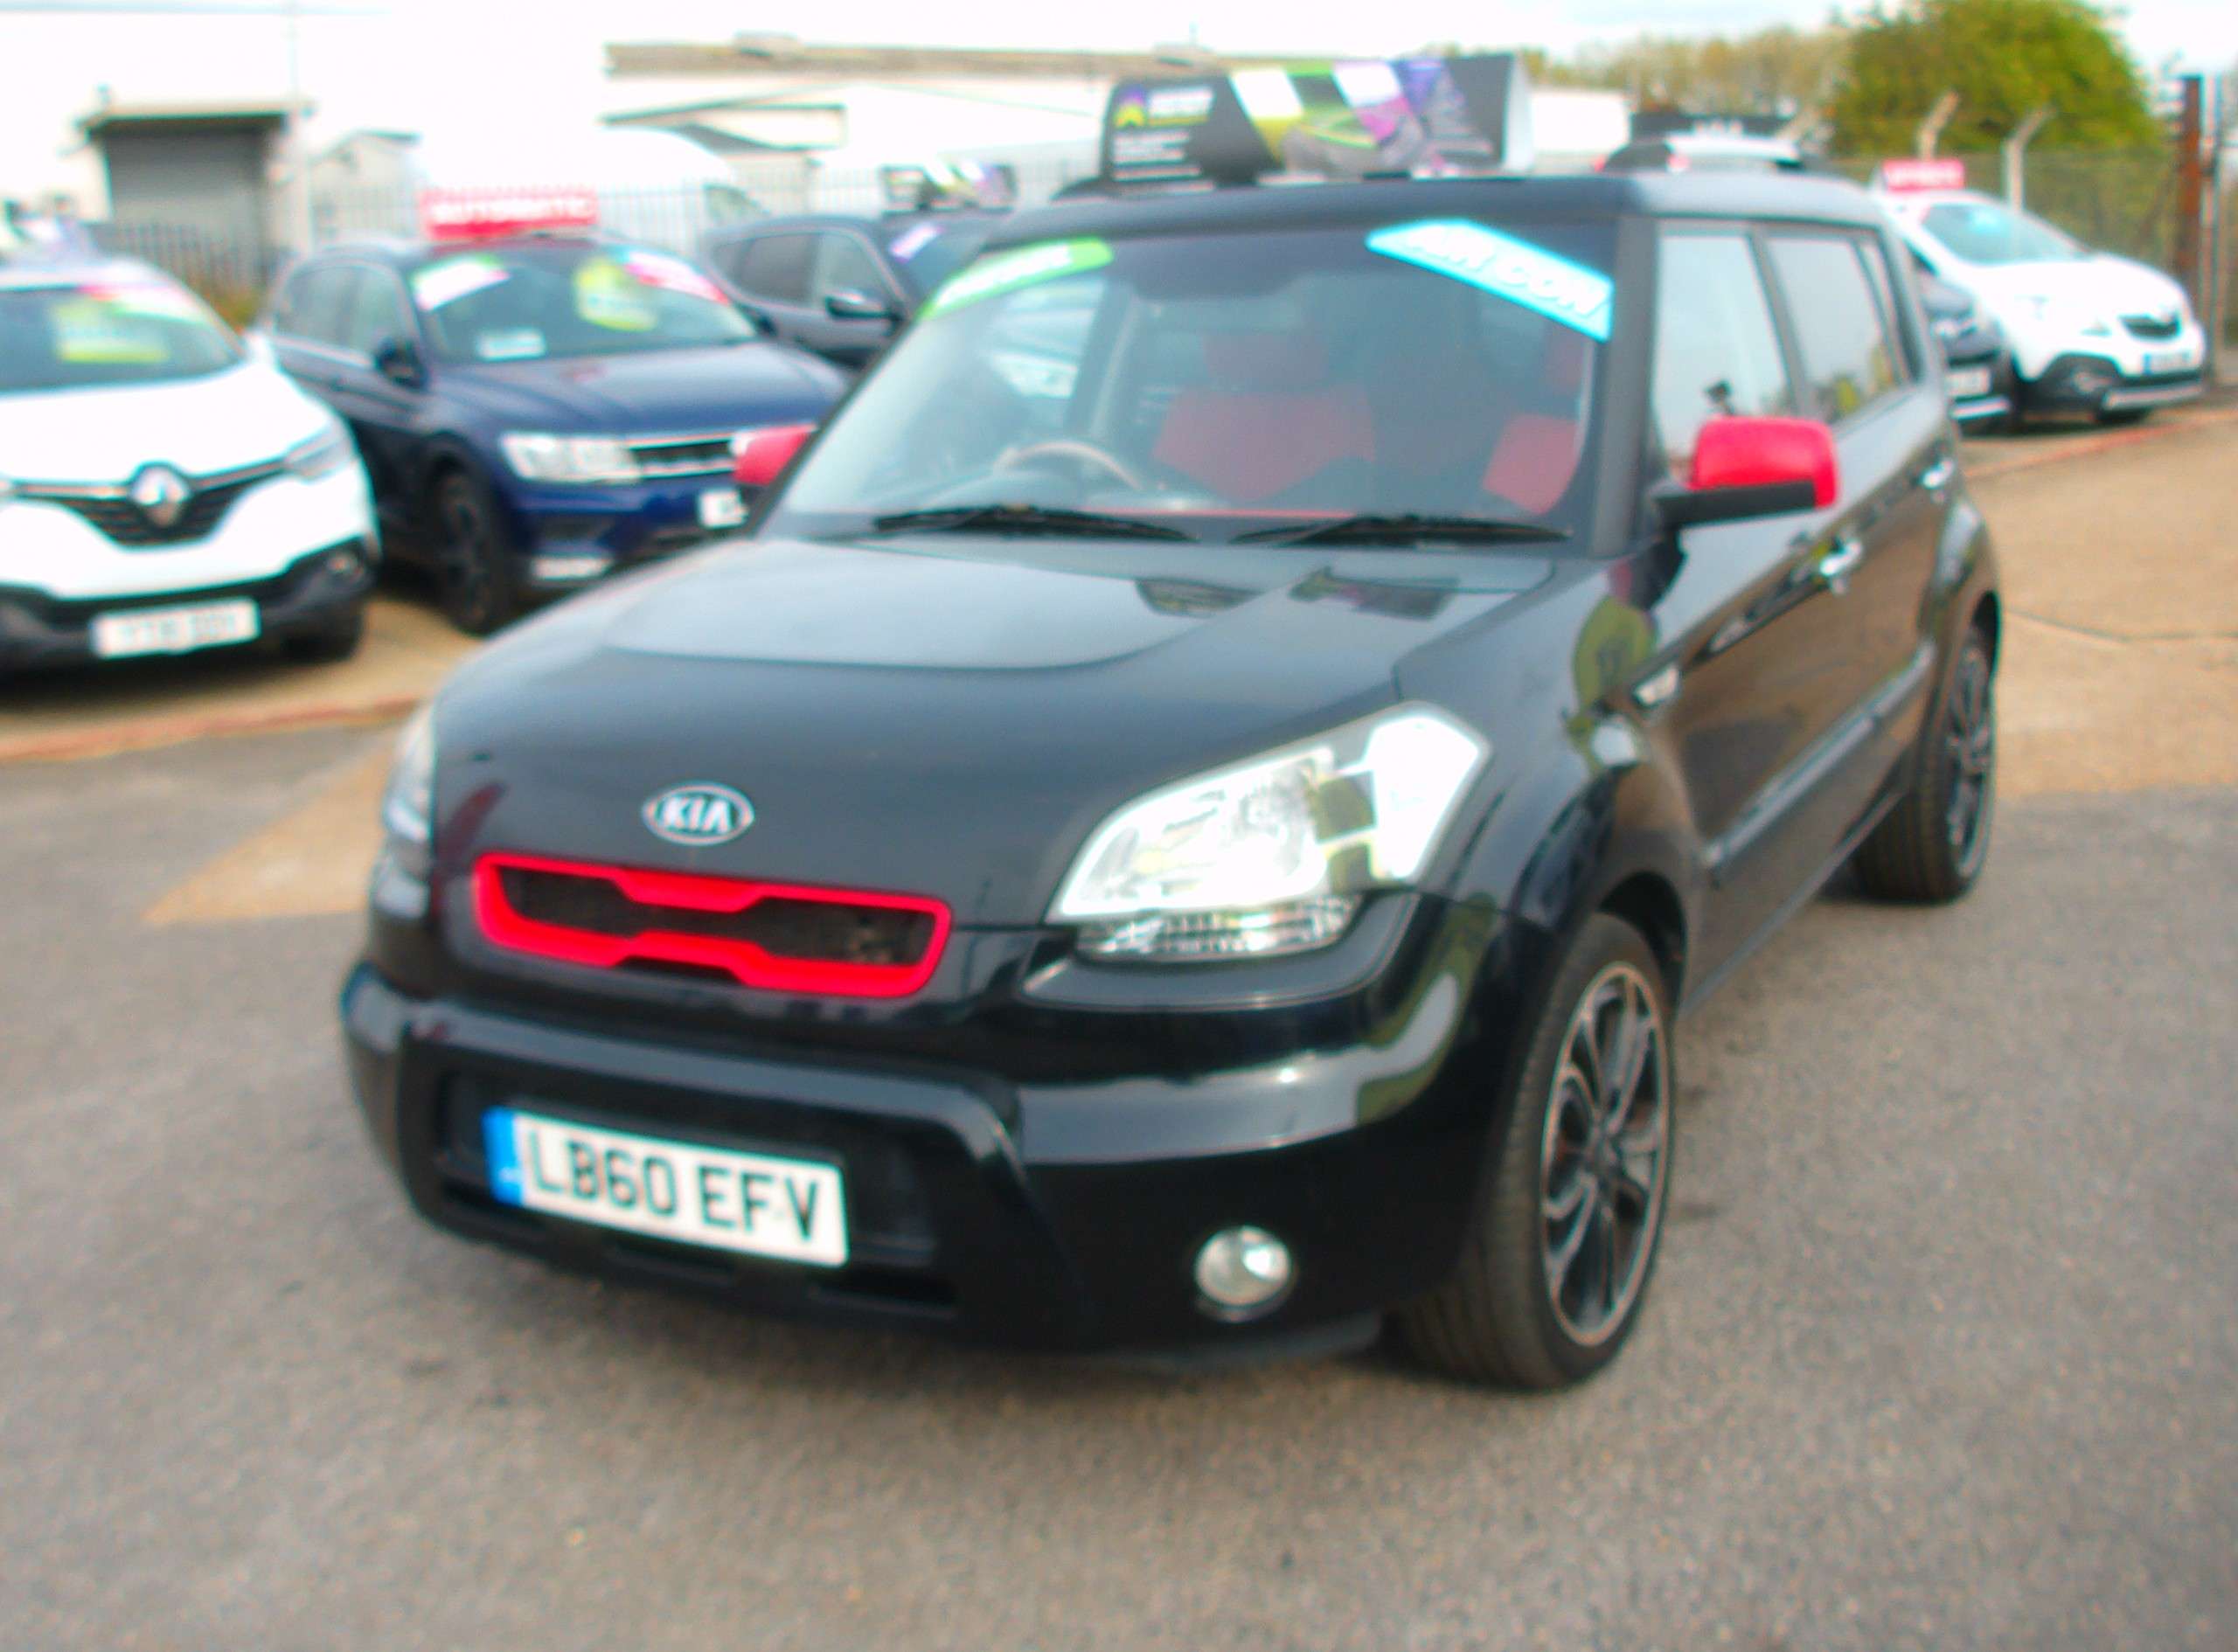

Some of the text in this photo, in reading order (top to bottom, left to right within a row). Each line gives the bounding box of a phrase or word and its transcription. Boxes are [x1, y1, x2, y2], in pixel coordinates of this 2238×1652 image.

[1402, 223, 1607, 317] AIR CON
[661, 795, 730, 832] KIA
[529, 1129, 819, 1242] LB60 EFV
